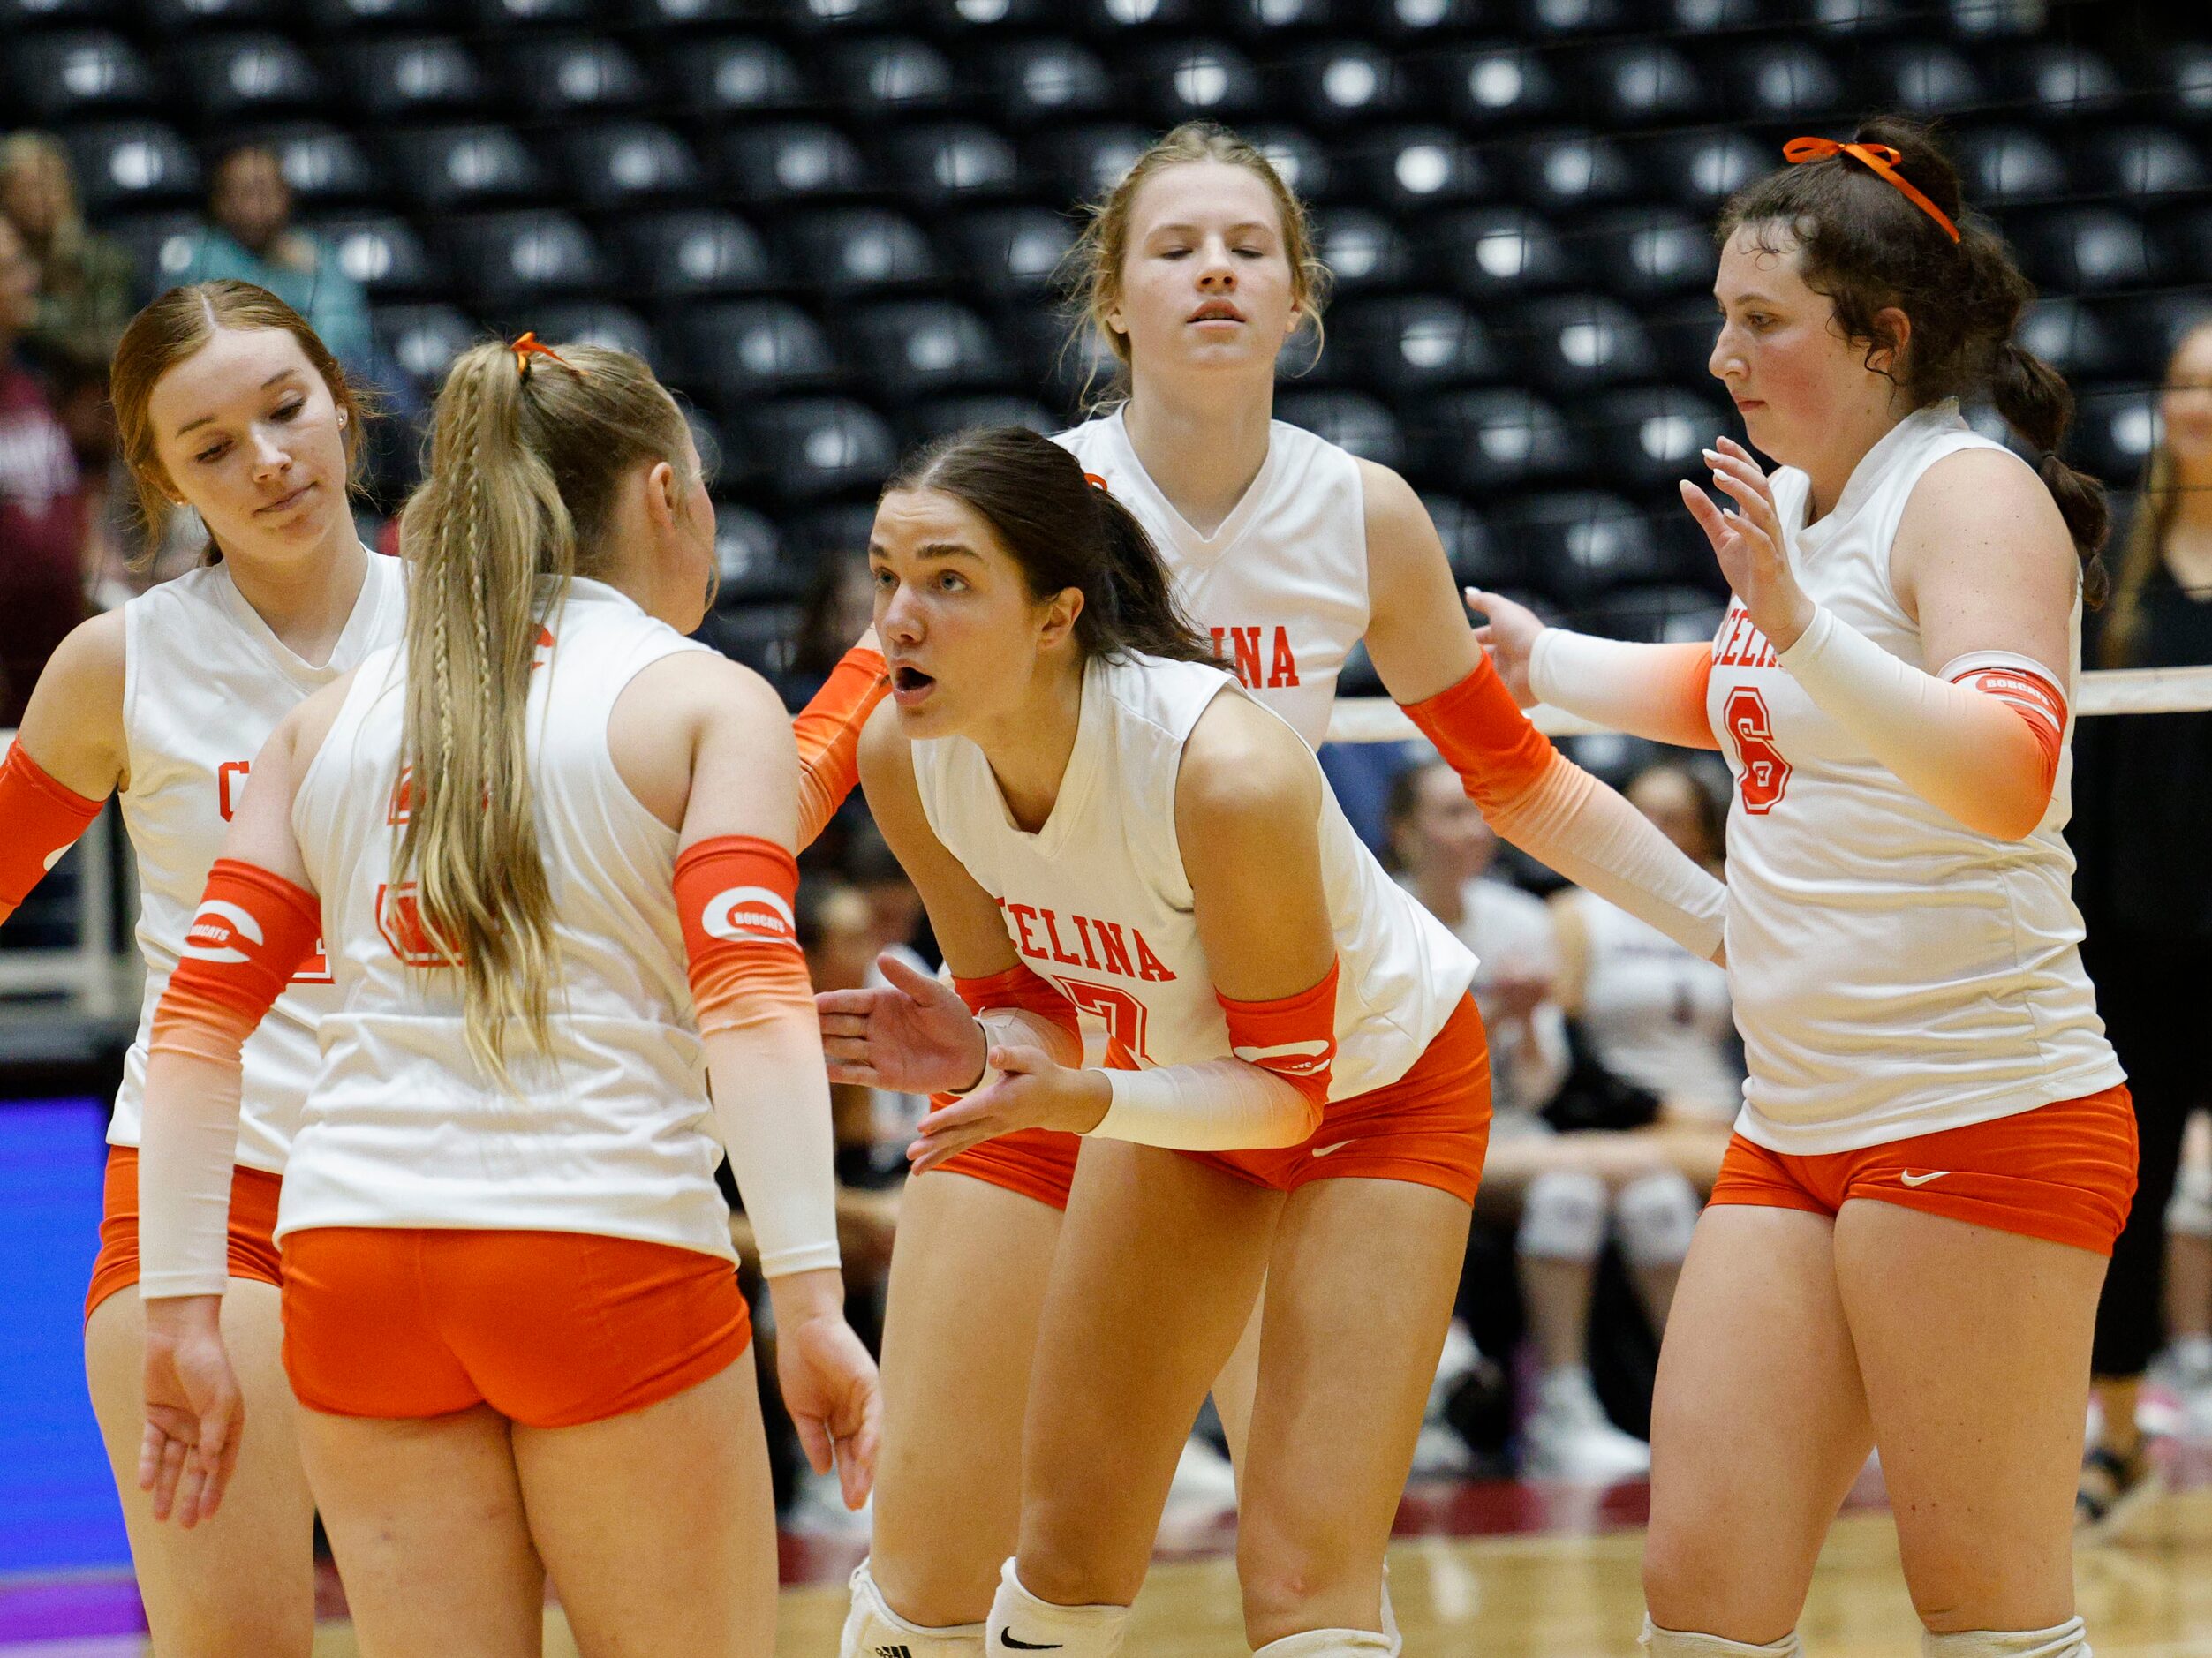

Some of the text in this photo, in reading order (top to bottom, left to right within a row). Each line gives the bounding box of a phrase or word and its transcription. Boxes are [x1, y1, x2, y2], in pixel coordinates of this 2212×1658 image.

[1210, 626, 1300, 689] INA
[1985, 679, 2050, 706] BOBCATS
[1723, 686, 1793, 815] 6
[734, 911, 786, 933] BOBCATS
[996, 896, 1177, 982] ELINA
[1051, 974, 1159, 1066] 7
